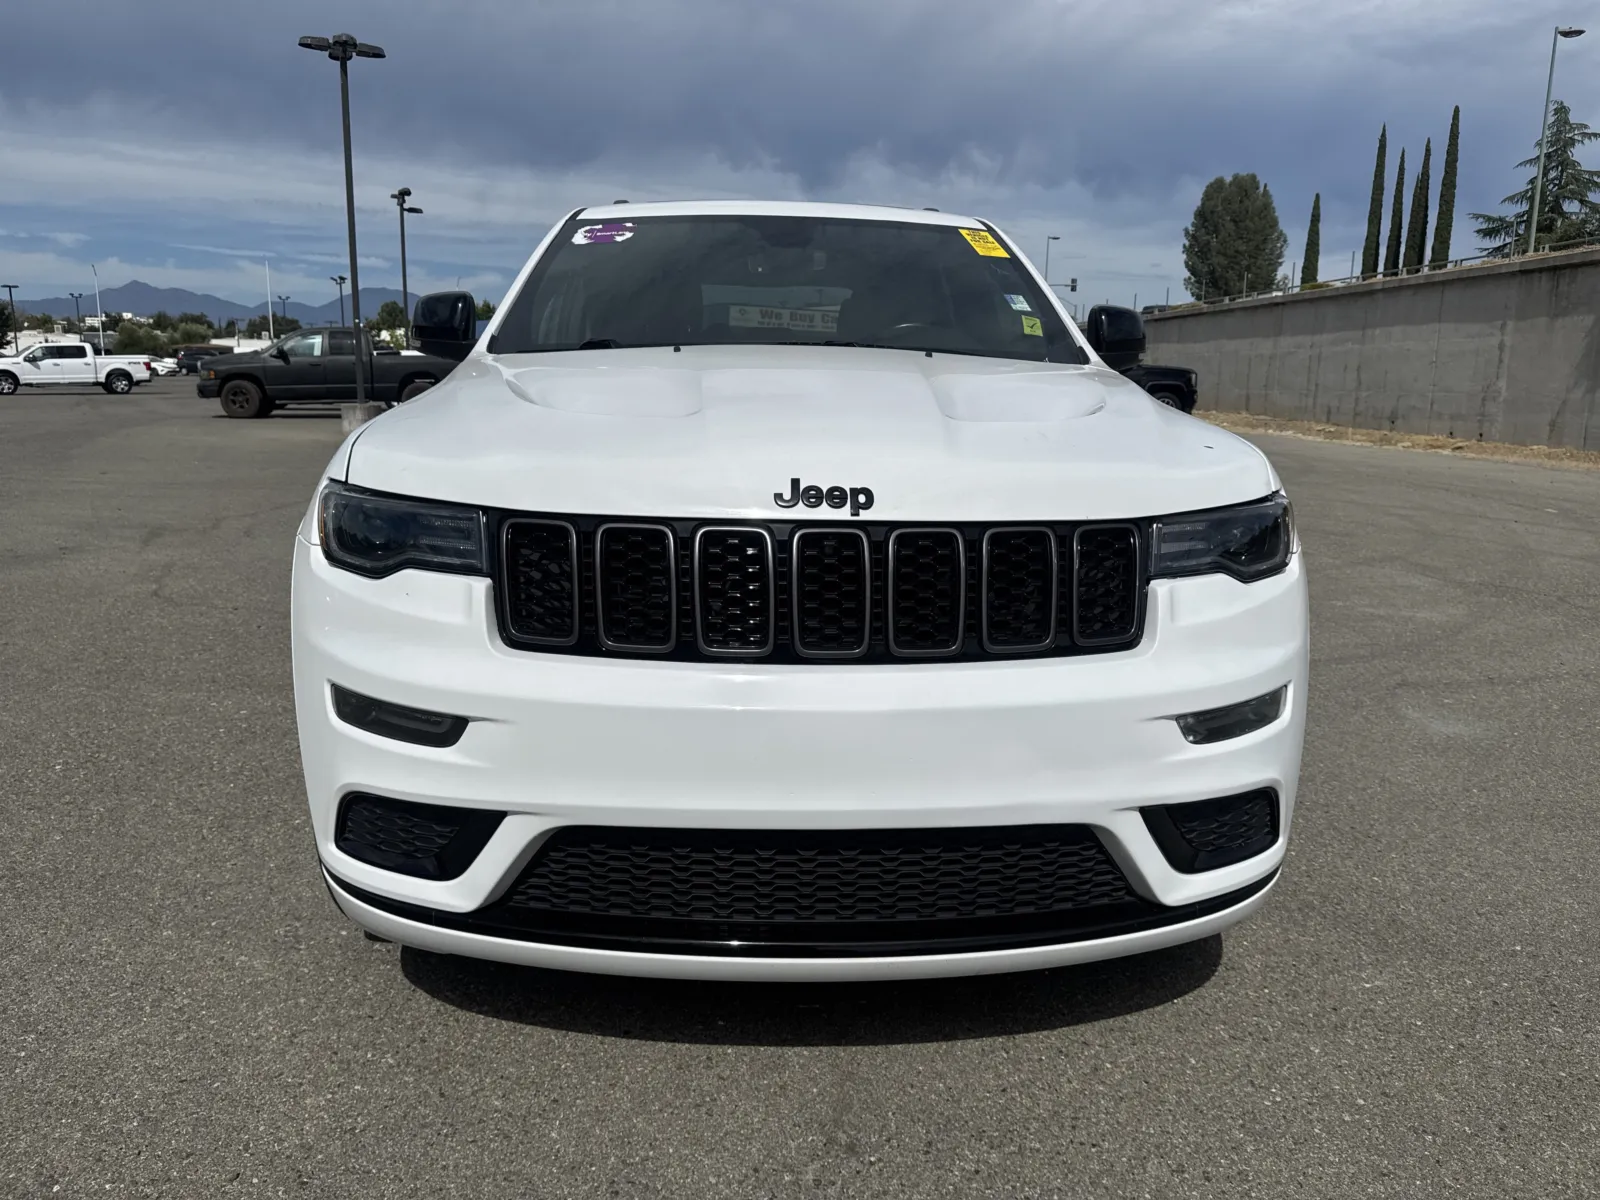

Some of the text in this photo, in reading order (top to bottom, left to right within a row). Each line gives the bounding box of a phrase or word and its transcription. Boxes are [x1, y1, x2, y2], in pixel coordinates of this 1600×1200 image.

[758, 308, 783, 321] We
[789, 311, 815, 324] Buy
[773, 477, 875, 517] Jeep
